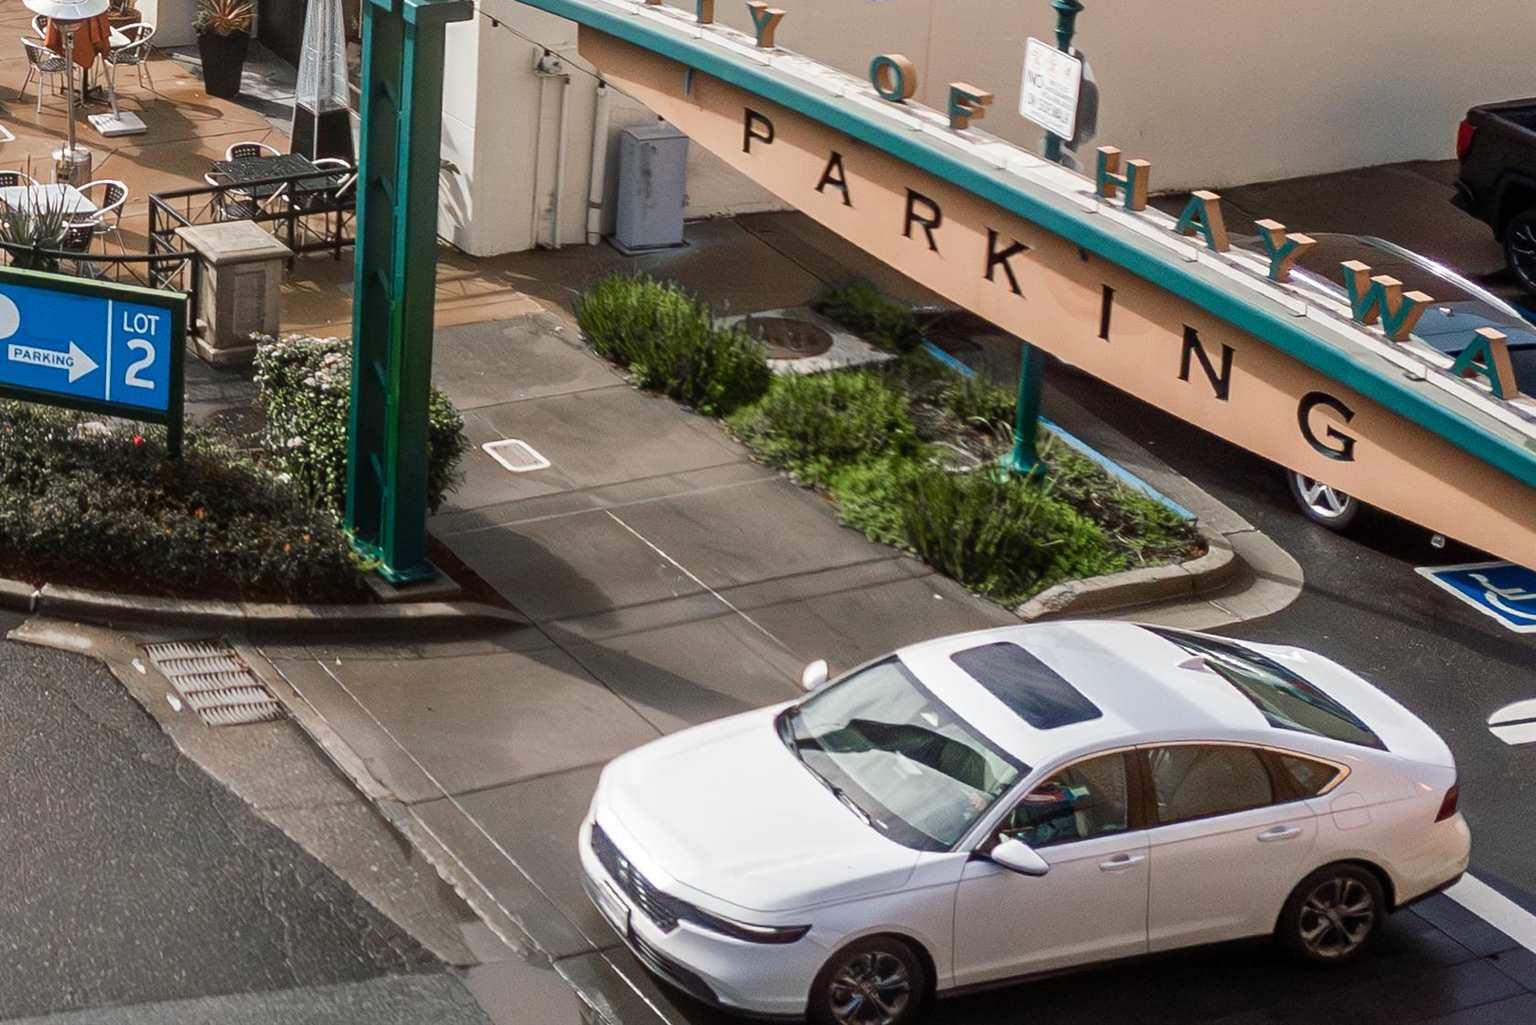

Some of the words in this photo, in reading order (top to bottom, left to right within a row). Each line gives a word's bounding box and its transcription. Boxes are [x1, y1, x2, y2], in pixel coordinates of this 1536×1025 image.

[869, 53, 994, 130] OF
[743, 107, 1359, 463] PARKING
[123, 311, 160, 336] LOT
[13, 347, 75, 367] PARKING
[125, 338, 156, 390] 2
